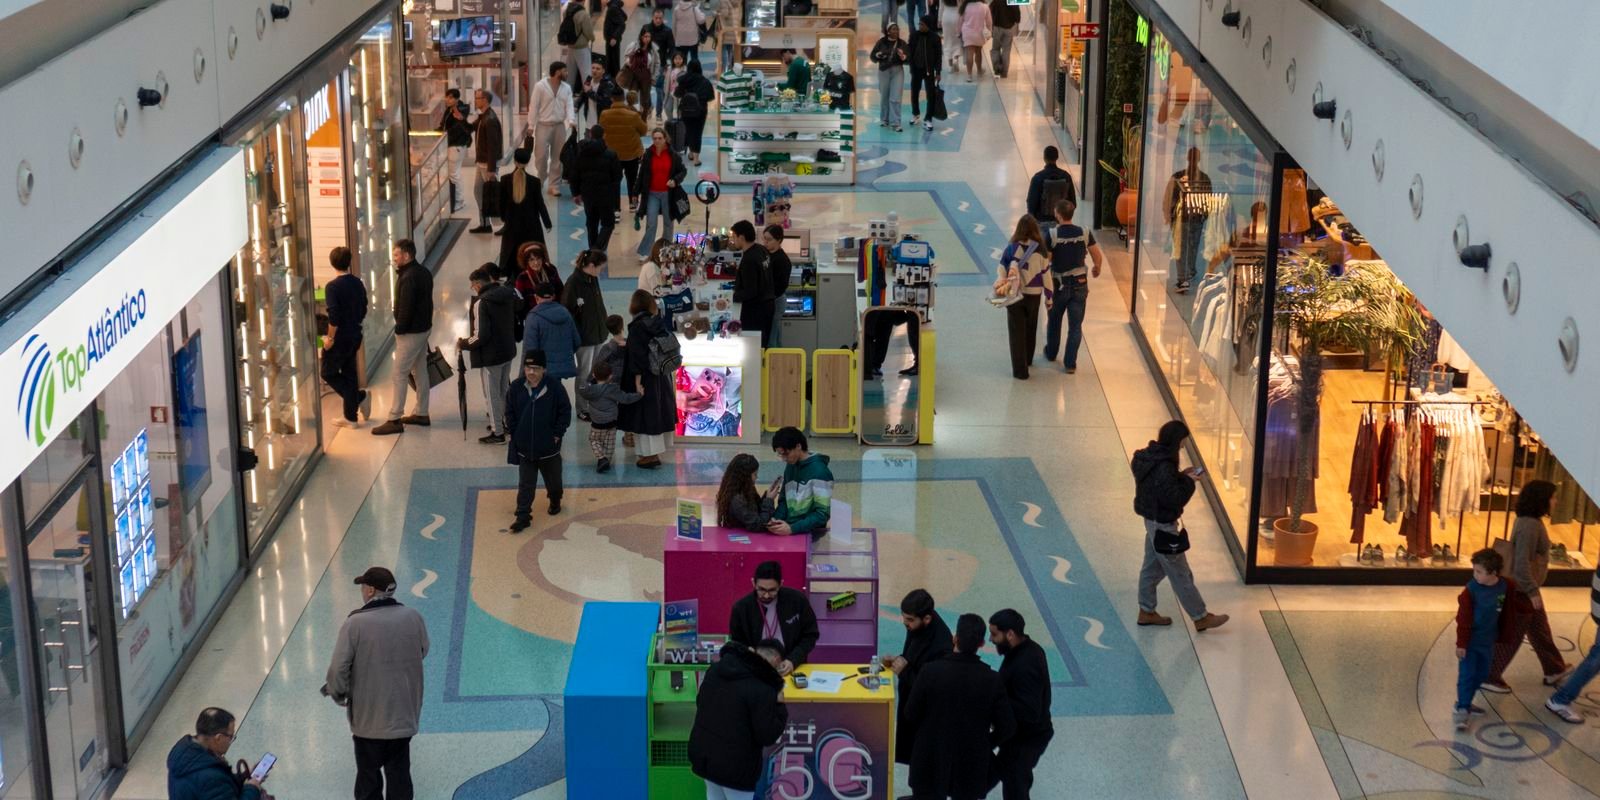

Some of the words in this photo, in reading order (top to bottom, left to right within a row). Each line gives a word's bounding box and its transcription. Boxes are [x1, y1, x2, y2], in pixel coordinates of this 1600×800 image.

[56, 288, 146, 394] TopAtlântico
[884, 423, 914, 435] hello!
[775, 724, 816, 744] tf
[778, 746, 873, 800] 5G
